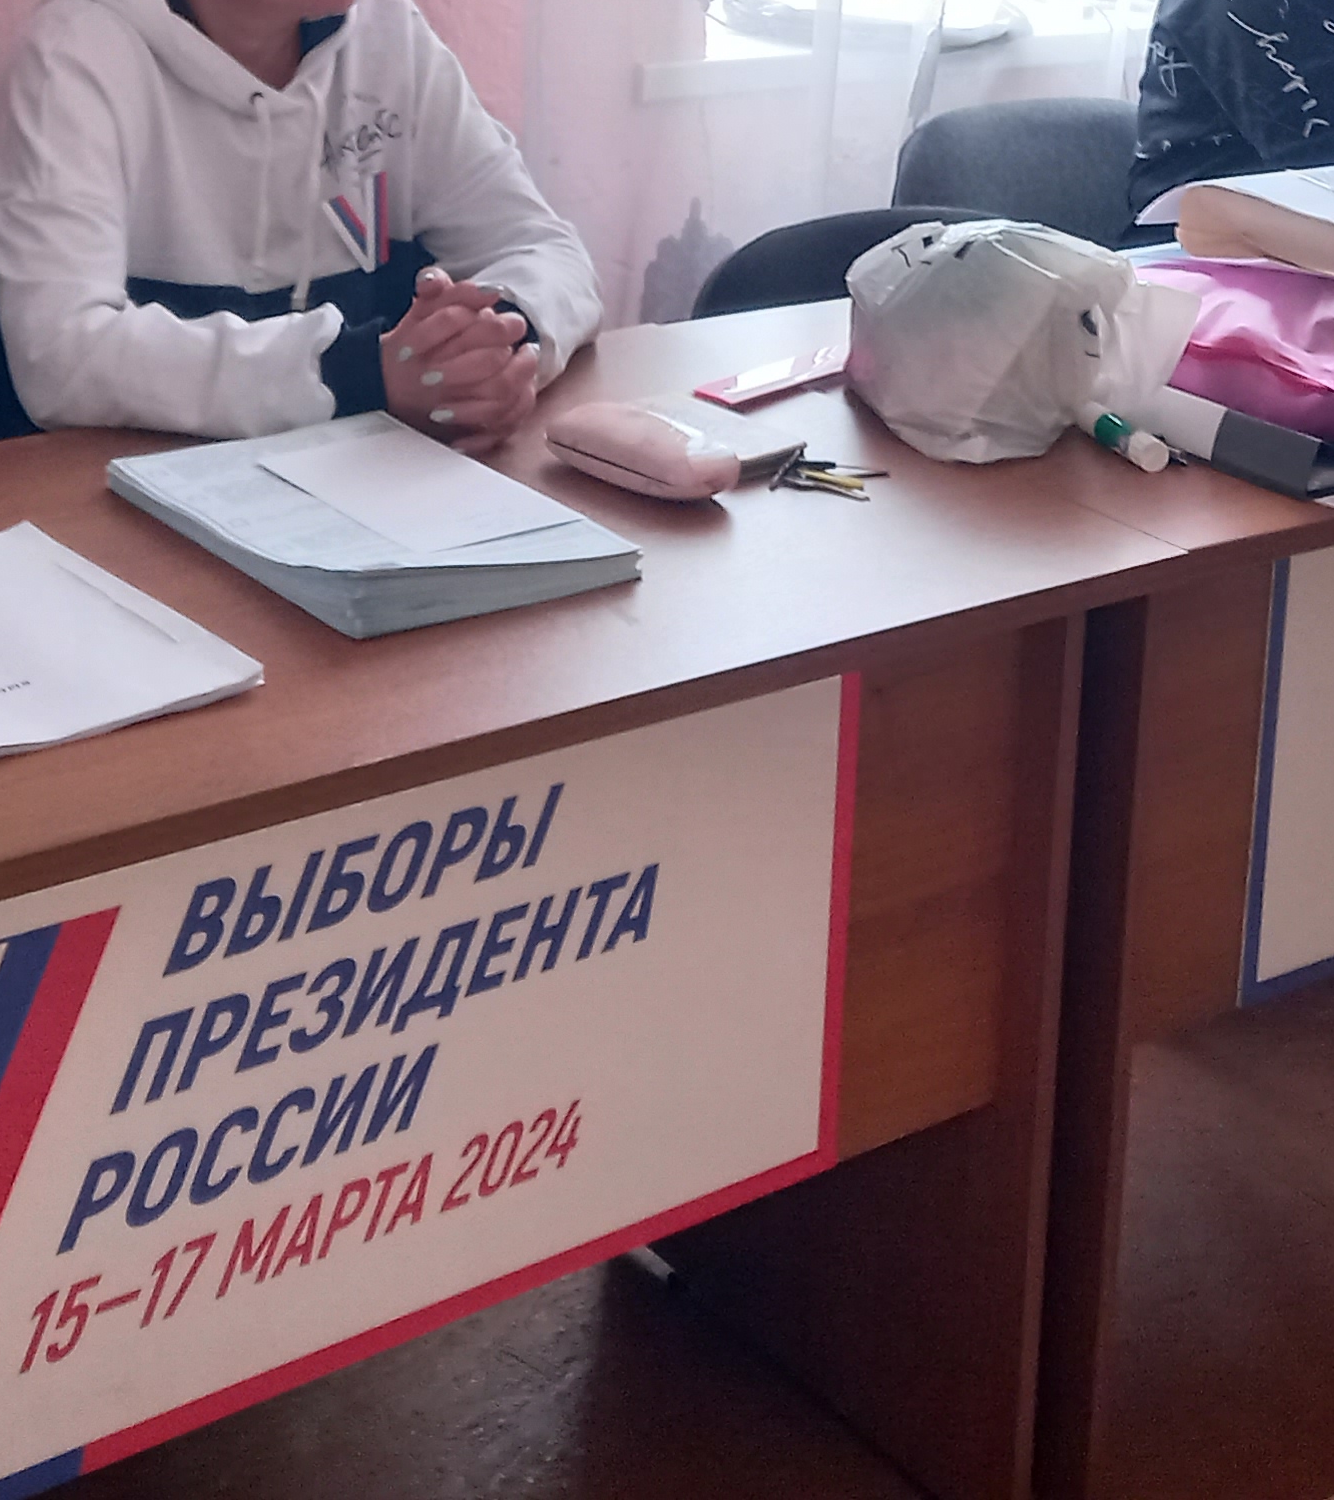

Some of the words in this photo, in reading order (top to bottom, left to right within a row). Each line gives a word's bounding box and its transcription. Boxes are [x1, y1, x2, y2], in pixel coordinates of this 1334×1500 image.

[162, 781, 565, 978] ВЫБОРЫ
[108, 862, 660, 1115] ПРЕЗИДЕНТА
[56, 1043, 439, 1256] РОССИИ
[216, 1152, 434, 1301] МАРТА
[439, 1099, 582, 1215] 2024
